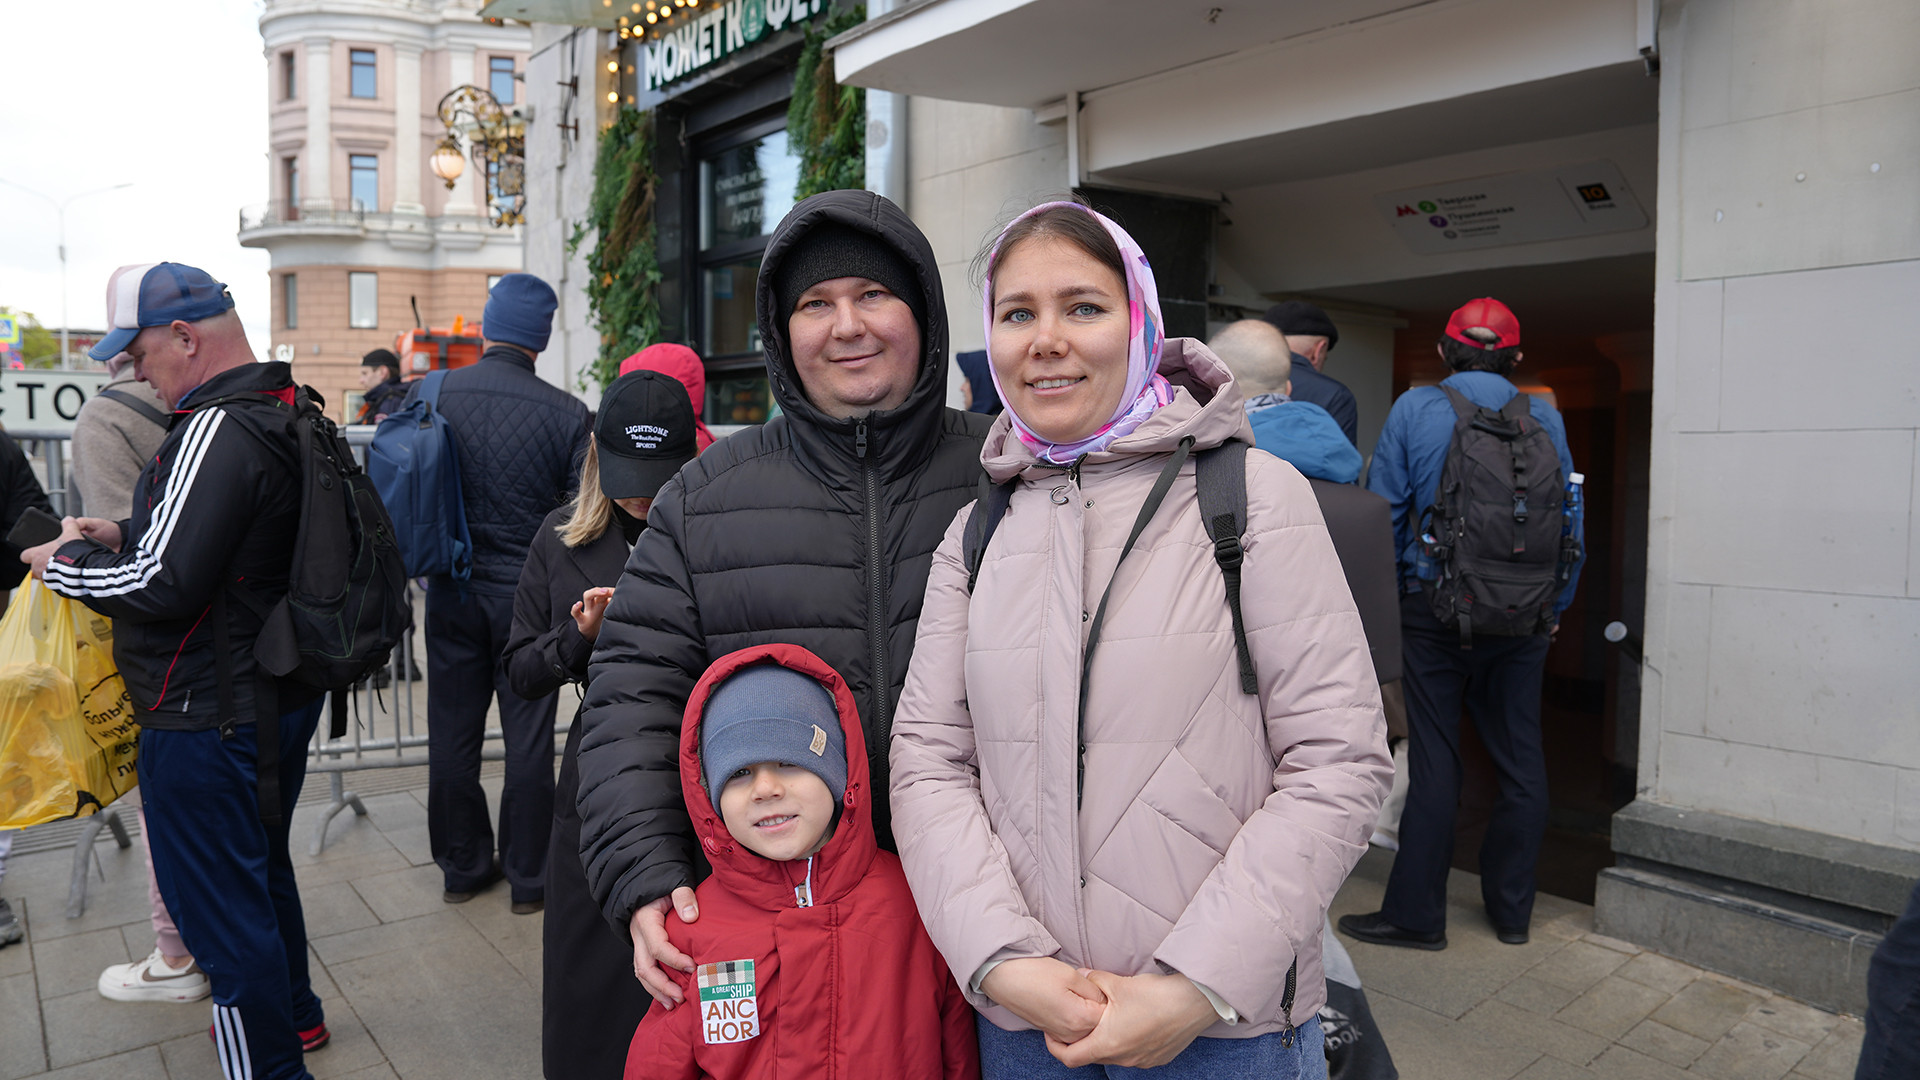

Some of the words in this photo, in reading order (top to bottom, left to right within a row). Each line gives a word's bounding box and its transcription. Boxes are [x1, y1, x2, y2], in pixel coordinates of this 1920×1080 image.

[644, 6, 726, 91] МОЖЕТ
[726, 0, 821, 53] КОФЕ
[1580, 186, 1605, 201] 10
[0, 383, 105, 421] ТО
[625, 424, 669, 437] LIGHTSOME
[730, 984, 753, 998] SHIP
[706, 998, 755, 1021] ANC
[707, 1021, 754, 1042] HOR
[1324, 1023, 1364, 1051] bok
